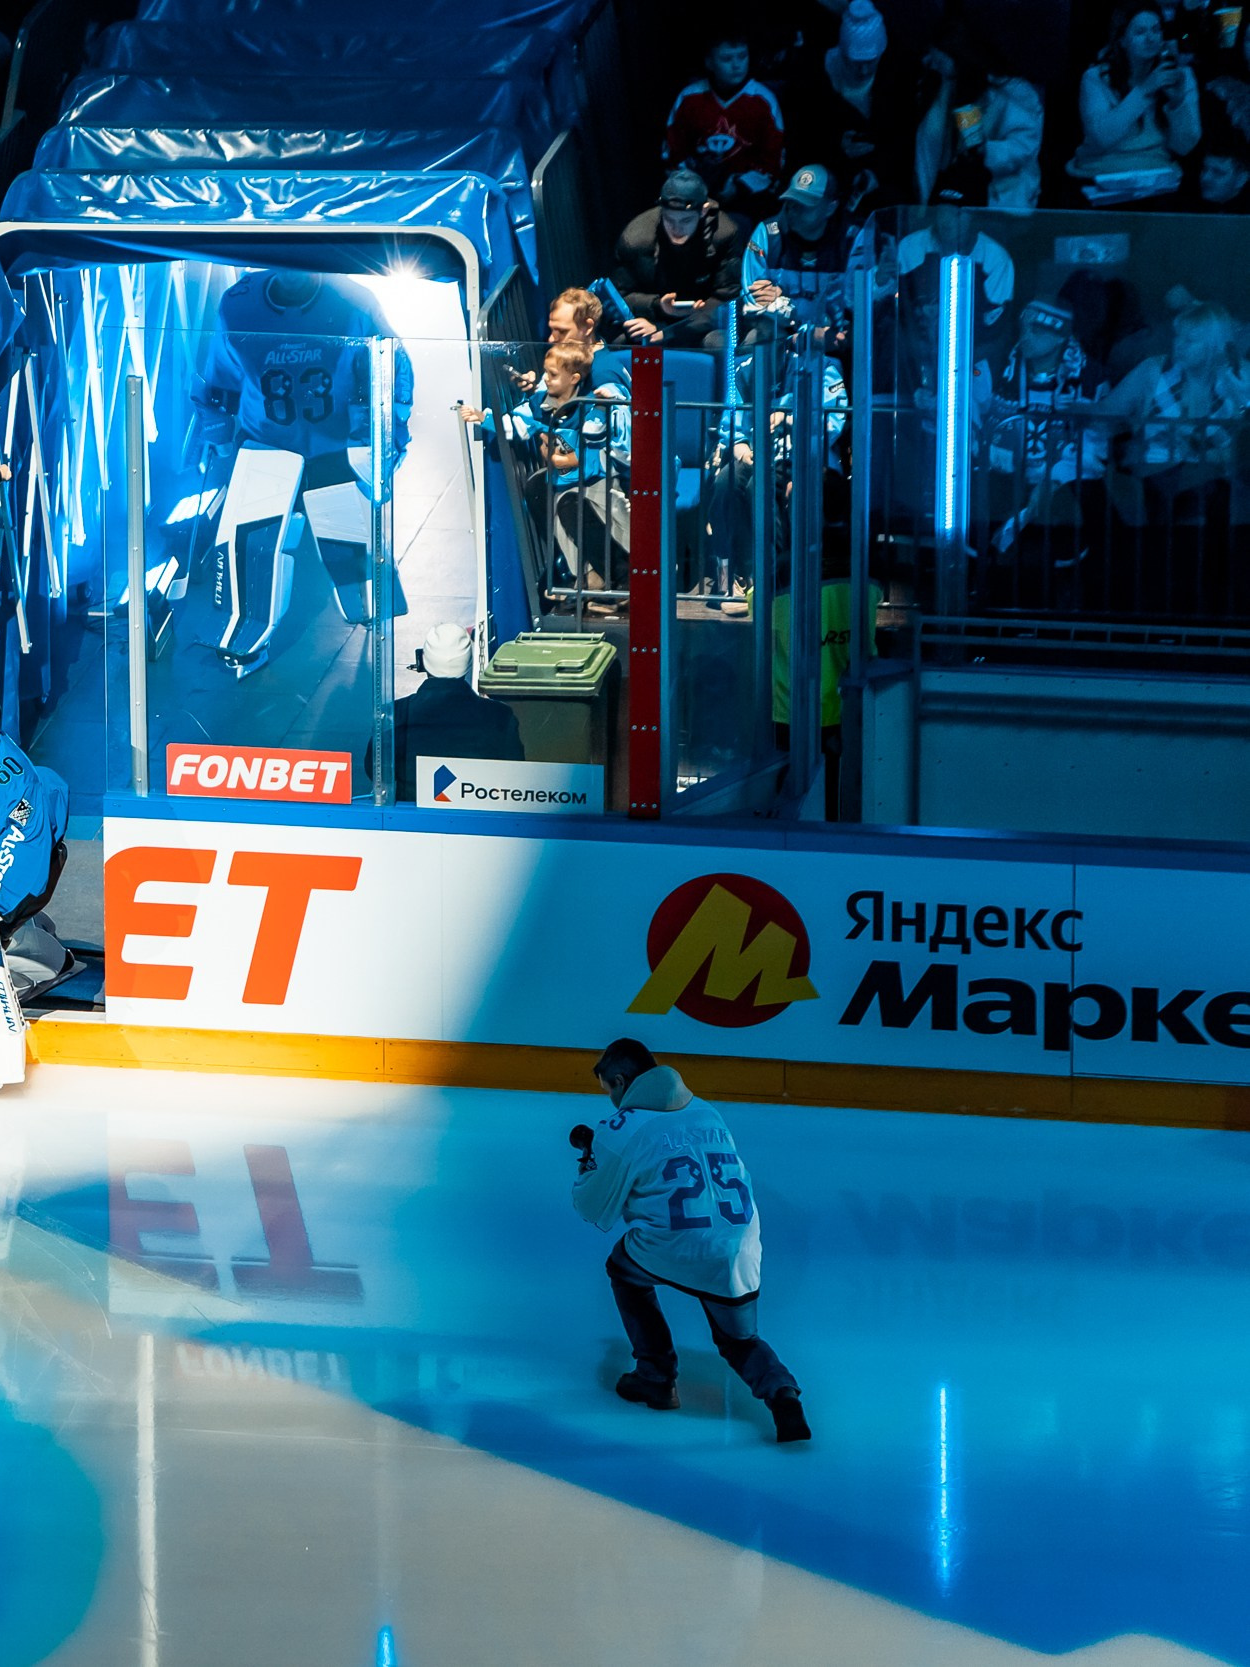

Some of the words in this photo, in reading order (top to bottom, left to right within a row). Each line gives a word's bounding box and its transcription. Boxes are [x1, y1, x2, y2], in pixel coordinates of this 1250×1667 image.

[260, 367, 335, 426] 83
[170, 752, 348, 795] FONBET
[460, 781, 587, 806] Ростелеком
[845, 890, 1084, 955] Яндекс
[661, 1152, 755, 1231] 25
